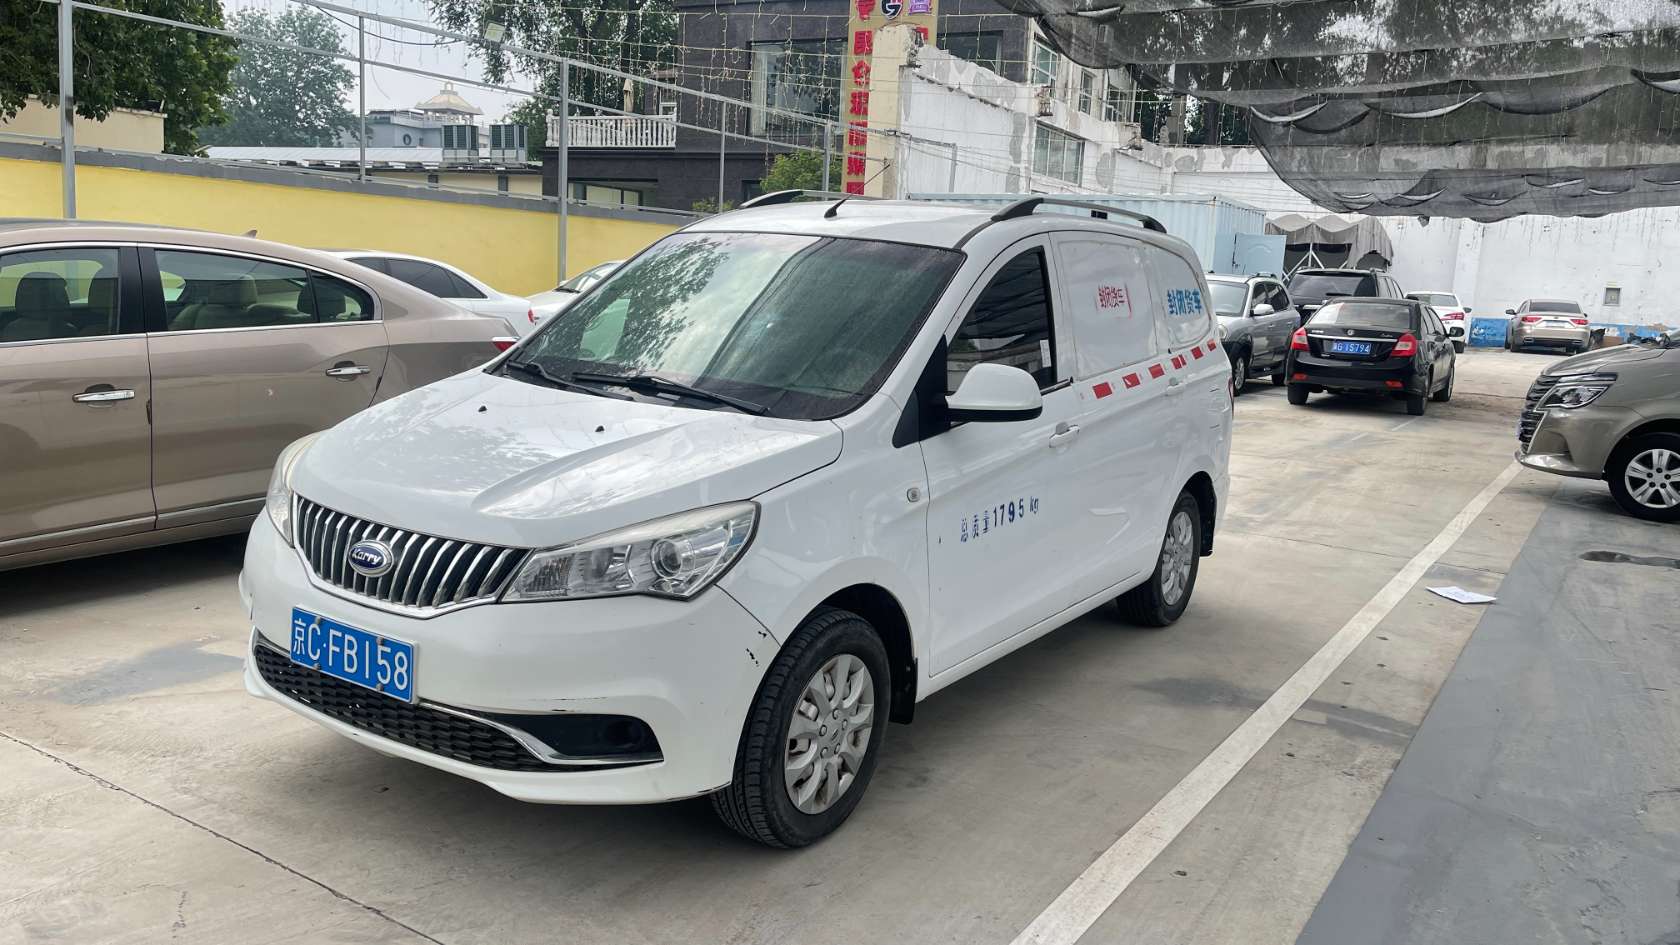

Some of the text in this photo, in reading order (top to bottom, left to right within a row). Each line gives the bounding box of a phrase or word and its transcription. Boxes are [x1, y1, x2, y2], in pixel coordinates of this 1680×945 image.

[1098, 285, 1125, 309] 封闭货车
[1167, 287, 1202, 316] 封闭货车
[351, 548, 382, 565] Karry
